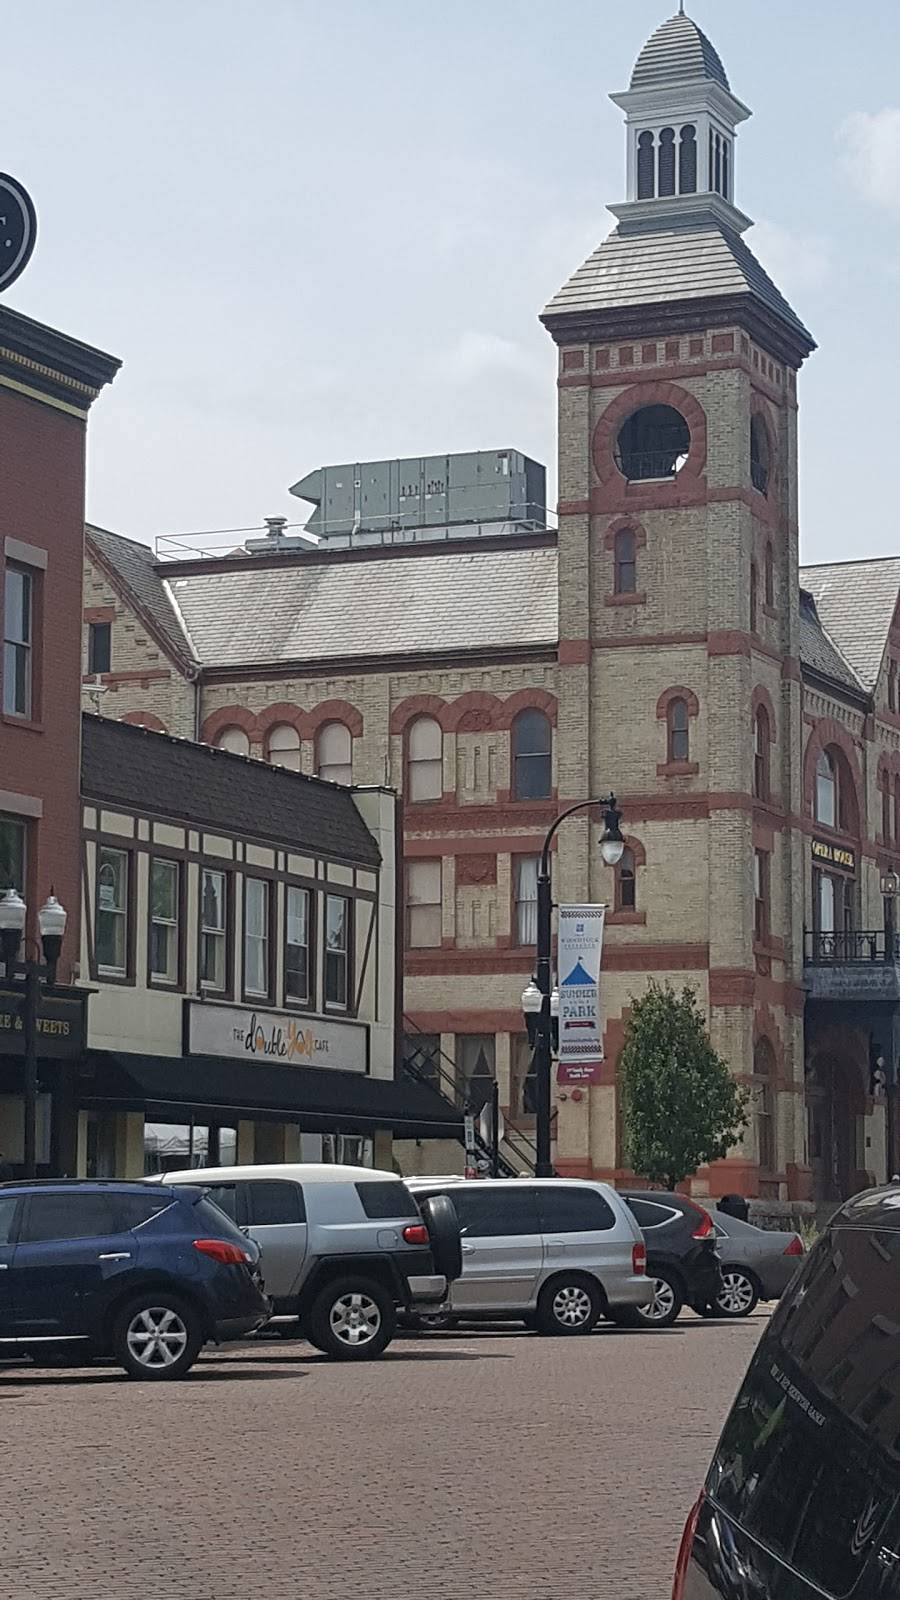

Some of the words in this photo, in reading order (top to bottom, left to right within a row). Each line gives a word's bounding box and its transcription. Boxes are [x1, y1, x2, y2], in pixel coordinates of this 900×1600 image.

[560, 989, 597, 998] SUMMER
[563, 1005, 596, 1017] PARK
[14, 1015, 22, 1030] &
[233, 1028, 245, 1042] THE
[245, 1013, 287, 1056] double
[314, 1039, 329, 1053] CAFE
